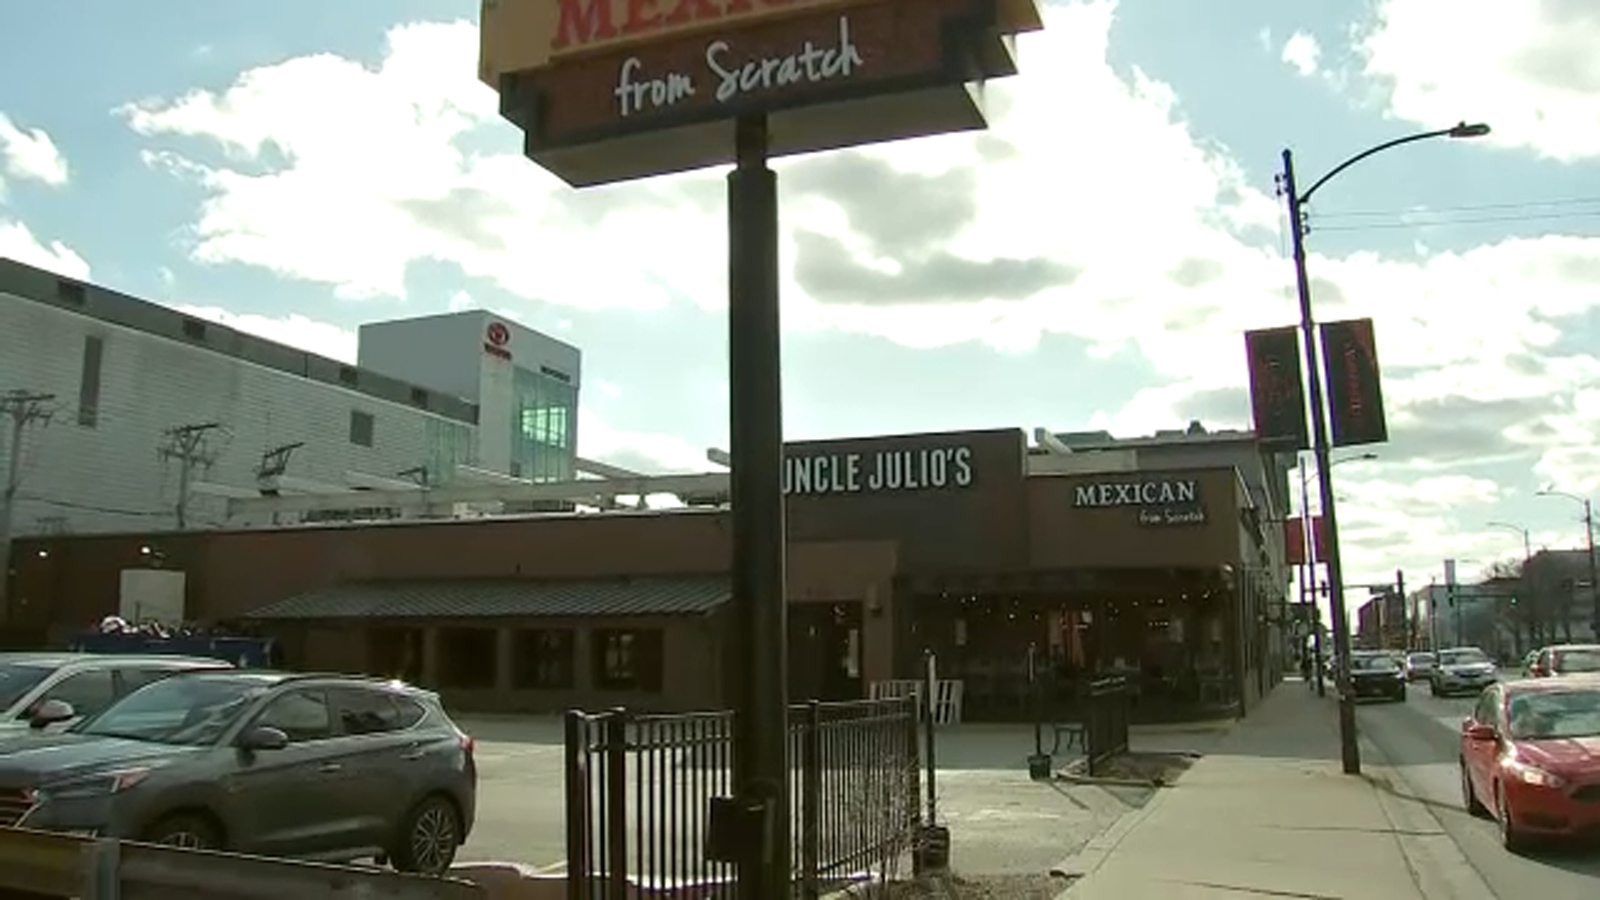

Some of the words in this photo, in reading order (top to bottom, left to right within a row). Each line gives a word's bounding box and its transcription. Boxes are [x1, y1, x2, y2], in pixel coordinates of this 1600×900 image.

[614, 57, 696, 116] from
[706, 16, 864, 102] Scratch
[869, 447, 972, 489] JULIO'S
[1074, 480, 1196, 507] MEXICAN
